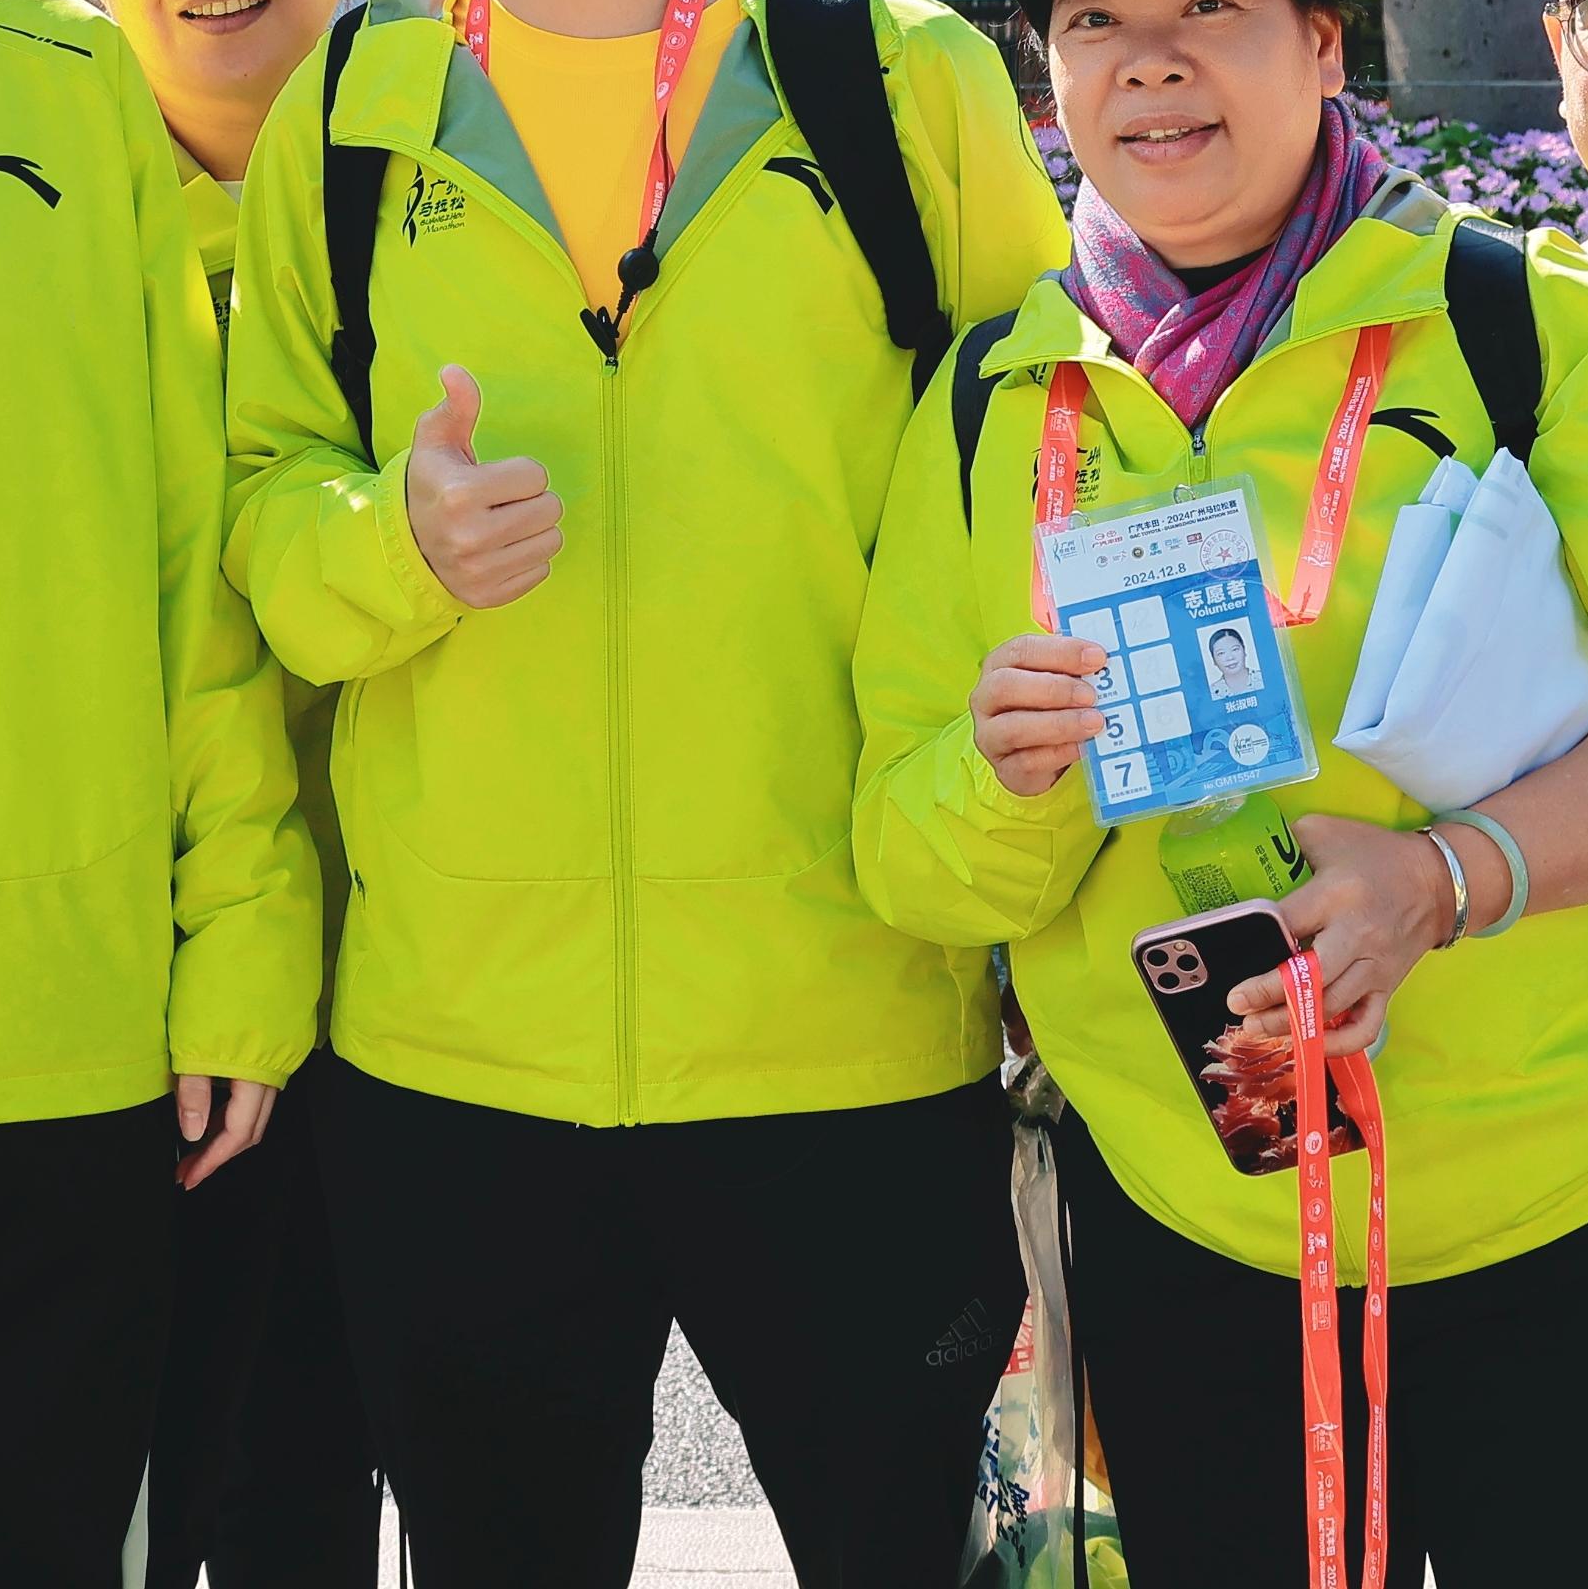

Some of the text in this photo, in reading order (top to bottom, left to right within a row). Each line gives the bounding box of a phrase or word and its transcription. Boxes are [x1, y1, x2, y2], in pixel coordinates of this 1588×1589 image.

[419, 196, 465, 216] 马拉松
[423, 220, 465, 235] Marathon
[1129, 532, 1141, 540] GAC
[1141, 527, 1161, 537] TOYOTA
[1196, 510, 1225, 523] MARATHON
[1122, 560, 1187, 588] 2024.12.8
[1181, 577, 1248, 611] 志愿者
[1188, 595, 1248, 621] Volunteer
[1092, 665, 1115, 692] 3
[1102, 713, 1125, 740] 5
[1113, 761, 1137, 788] 7
[1214, 767, 1261, 789] GM15547
[1306, 1231, 1315, 1255] AIMS
